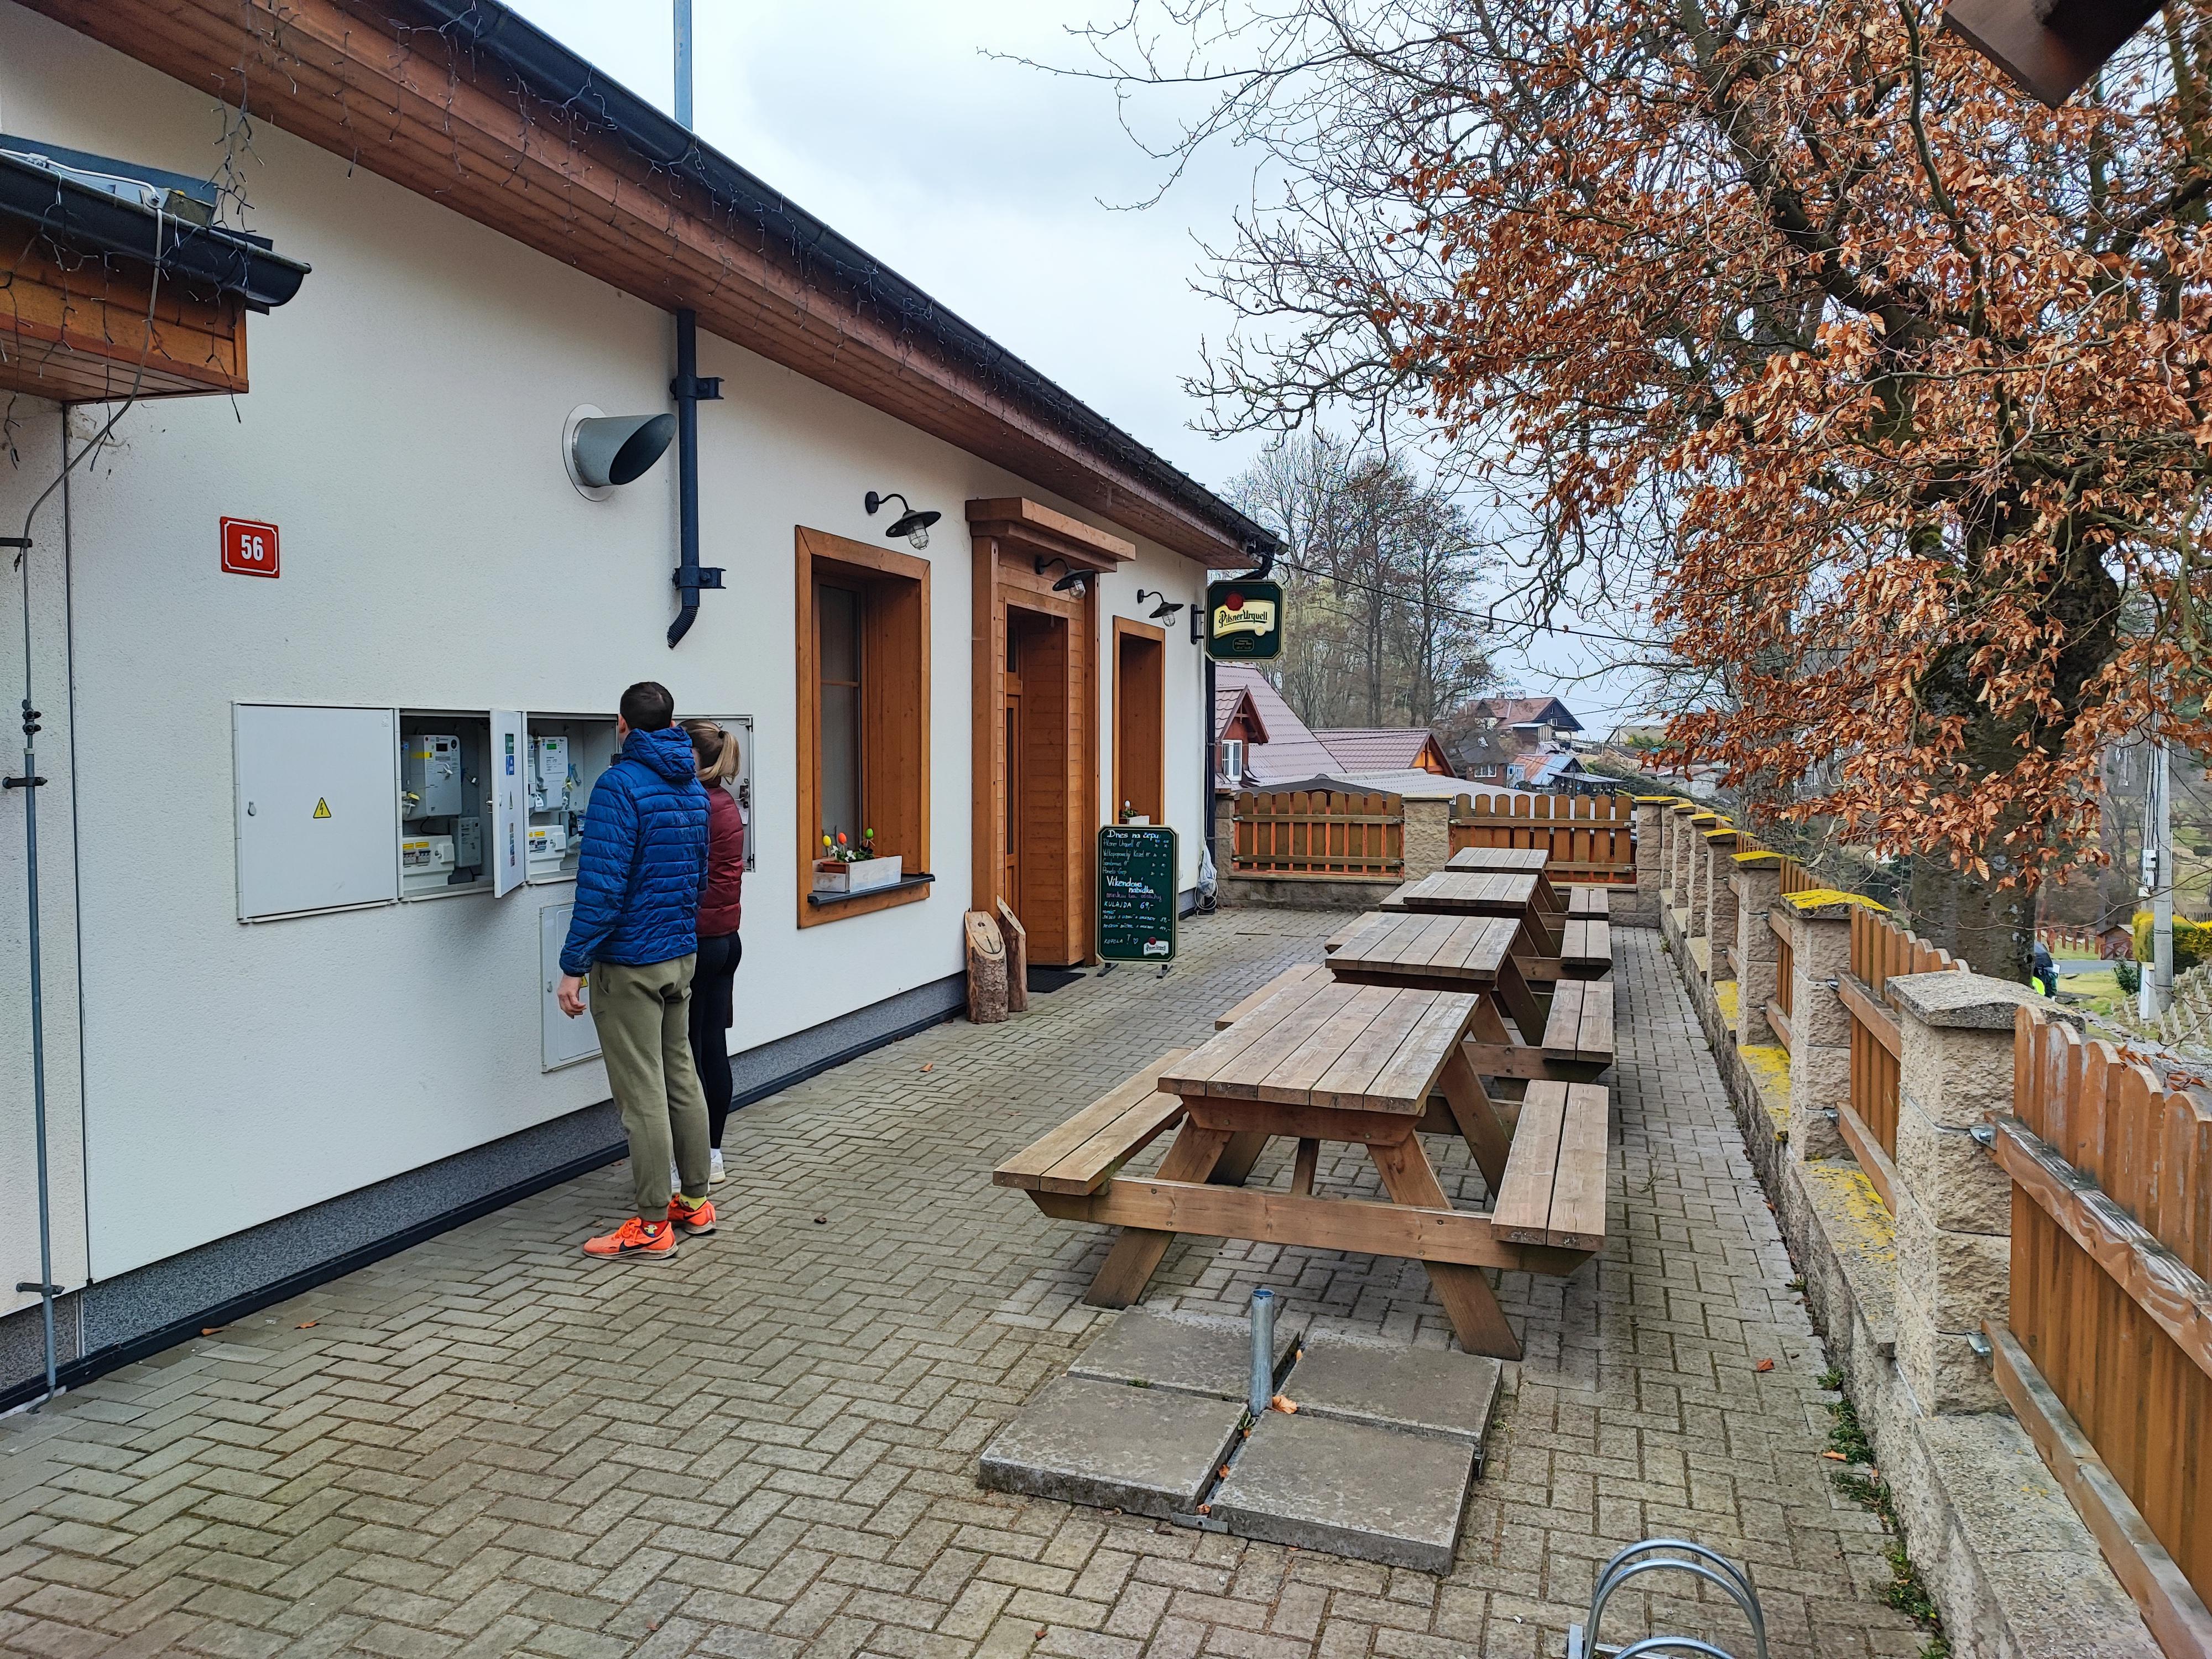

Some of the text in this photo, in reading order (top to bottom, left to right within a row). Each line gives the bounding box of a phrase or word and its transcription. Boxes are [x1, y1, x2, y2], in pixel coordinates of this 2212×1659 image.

[241, 534, 264, 561] 56
[1218, 609, 1267, 628] Pilsner Urquell
[1107, 830, 1128, 838] Dnes
[1106, 875, 1144, 887] Víkendová
[1128, 885, 1154, 894] nabídka
